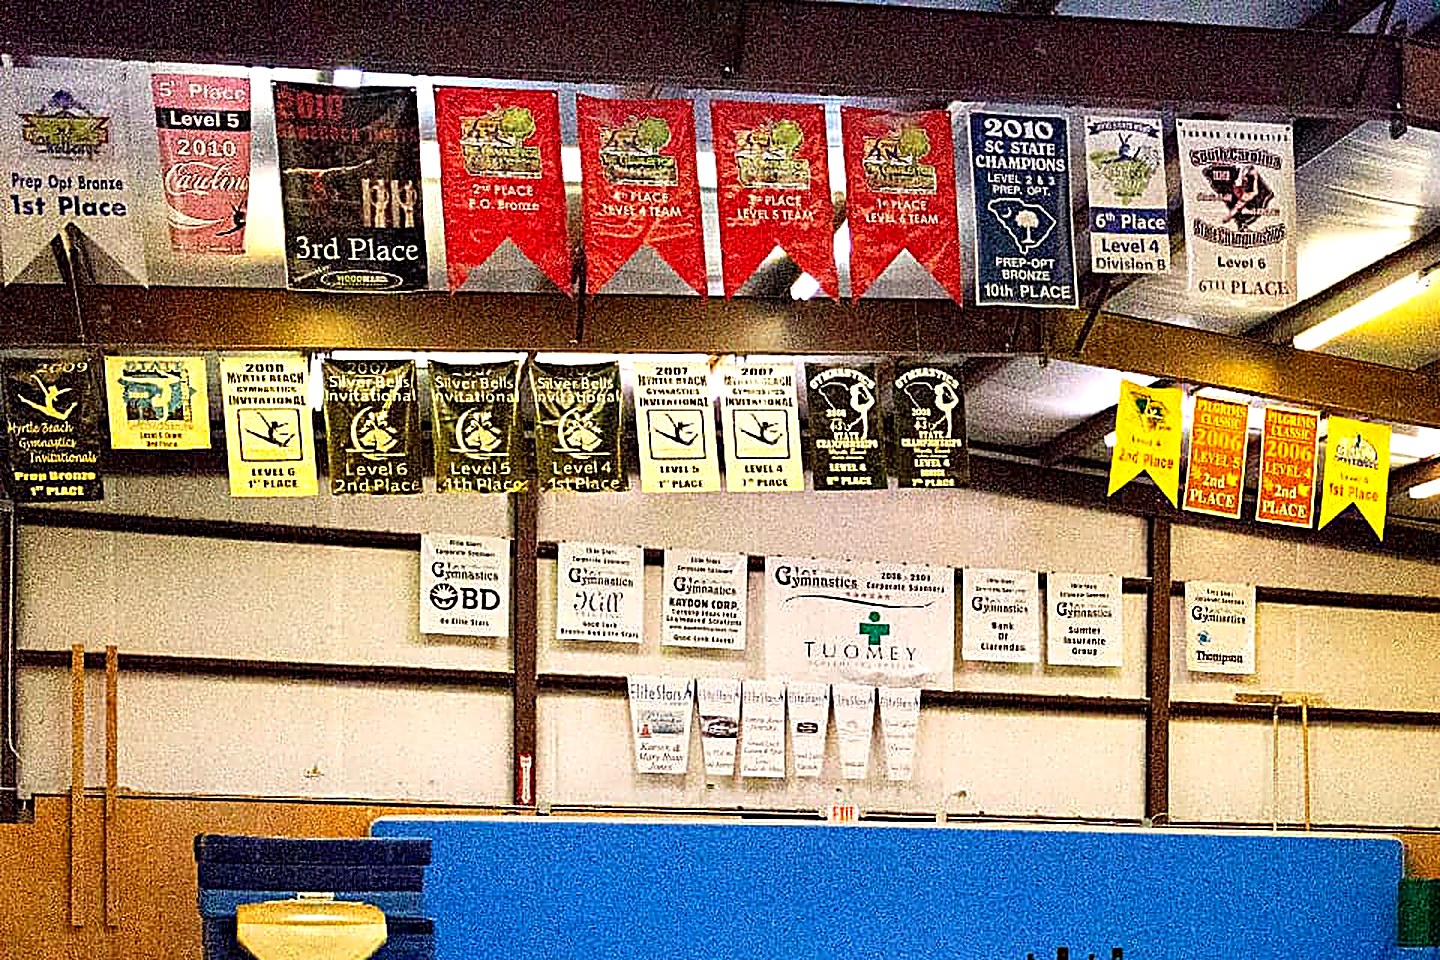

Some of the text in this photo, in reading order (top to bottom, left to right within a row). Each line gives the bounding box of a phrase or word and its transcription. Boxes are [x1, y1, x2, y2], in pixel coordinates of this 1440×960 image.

[189, 83, 246, 102] Place
[170, 109, 240, 128] Level 5
[984, 117, 1054, 140] 2010
[177, 138, 237, 157] 2010
[984, 141, 1056, 158] SC STATE
[975, 155, 1066, 172] CHAMPIONS
[1190, 147, 1282, 169] South Carolina
[11, 172, 124, 192] Prep Opt Bronze
[987, 172, 1022, 185] LEVEL
[494, 184, 534, 197] PLACE
[630, 191, 670, 204] PLACE
[992, 185, 1051, 197] PREP. OPT.
[10, 194, 127, 218] 1st Place
[764, 194, 802, 207] PLACE
[891, 199, 928, 212] PLACE
[649, 206, 683, 217] TEAM
[737, 207, 814, 222] LEVEL TEAM
[865, 212, 939, 225] LEVEL TEAM
[1095, 211, 1166, 231] 6th Place
[297, 235, 419, 263] 3rd Place
[1101, 238, 1160, 254] Level 4
[995, 256, 1056, 270] PREP-OPT
[1095, 256, 1167, 272] Division B
[1217, 255, 1266, 269] Level 6
[1002, 268, 1051, 282] BRONZE
[984, 284, 1072, 300] 10th PLACE
[1198, 279, 1290, 296] 6TH PLACE
[329, 375, 411, 390] Silver Bells
[435, 376, 515, 391] Silver Bells
[537, 376, 615, 391] Silver Bells
[327, 388, 416, 403] Invitational
[1197, 399, 1247, 419] PILGRIMS
[1199, 413, 1241, 430] CLASSIC
[1266, 409, 1317, 429] PILGRIMS
[1195, 428, 1242, 450] 2006
[1270, 422, 1312, 442] CLASSIC
[1266, 439, 1313, 462] 2006
[1143, 453, 1174, 470] Place
[1193, 450, 1241, 469] LEVEL 5
[251, 467, 286, 477] LEVEL
[345, 462, 409, 477] Level 6
[450, 461, 511, 476] Level 5
[551, 461, 613, 475] Level 4
[744, 464, 772, 474] LEVEL
[1263, 460, 1312, 479] LEVEL 4
[14, 470, 97, 483] Prep Bronze
[548, 478, 620, 491] 1st Place
[757, 479, 788, 488] PLACE
[1202, 470, 1226, 490] 2nd
[46, 485, 85, 497] PLACE
[263, 480, 298, 490] PLACE
[335, 478, 421, 494] 2nd Place
[442, 478, 472, 492] 4th
[672, 480, 703, 490] PLACE
[1273, 481, 1298, 501] 2nd
[1189, 486, 1235, 510] PLACE
[1348, 486, 1380, 502] Place
[1261, 498, 1308, 520] PLACE
[431, 561, 500, 582] Gymnastics
[568, 567, 635, 588] Gymnastics
[775, 565, 858, 589] Gymnastics
[460, 586, 501, 611] BD
[803, 641, 918, 661] TUOMEY
